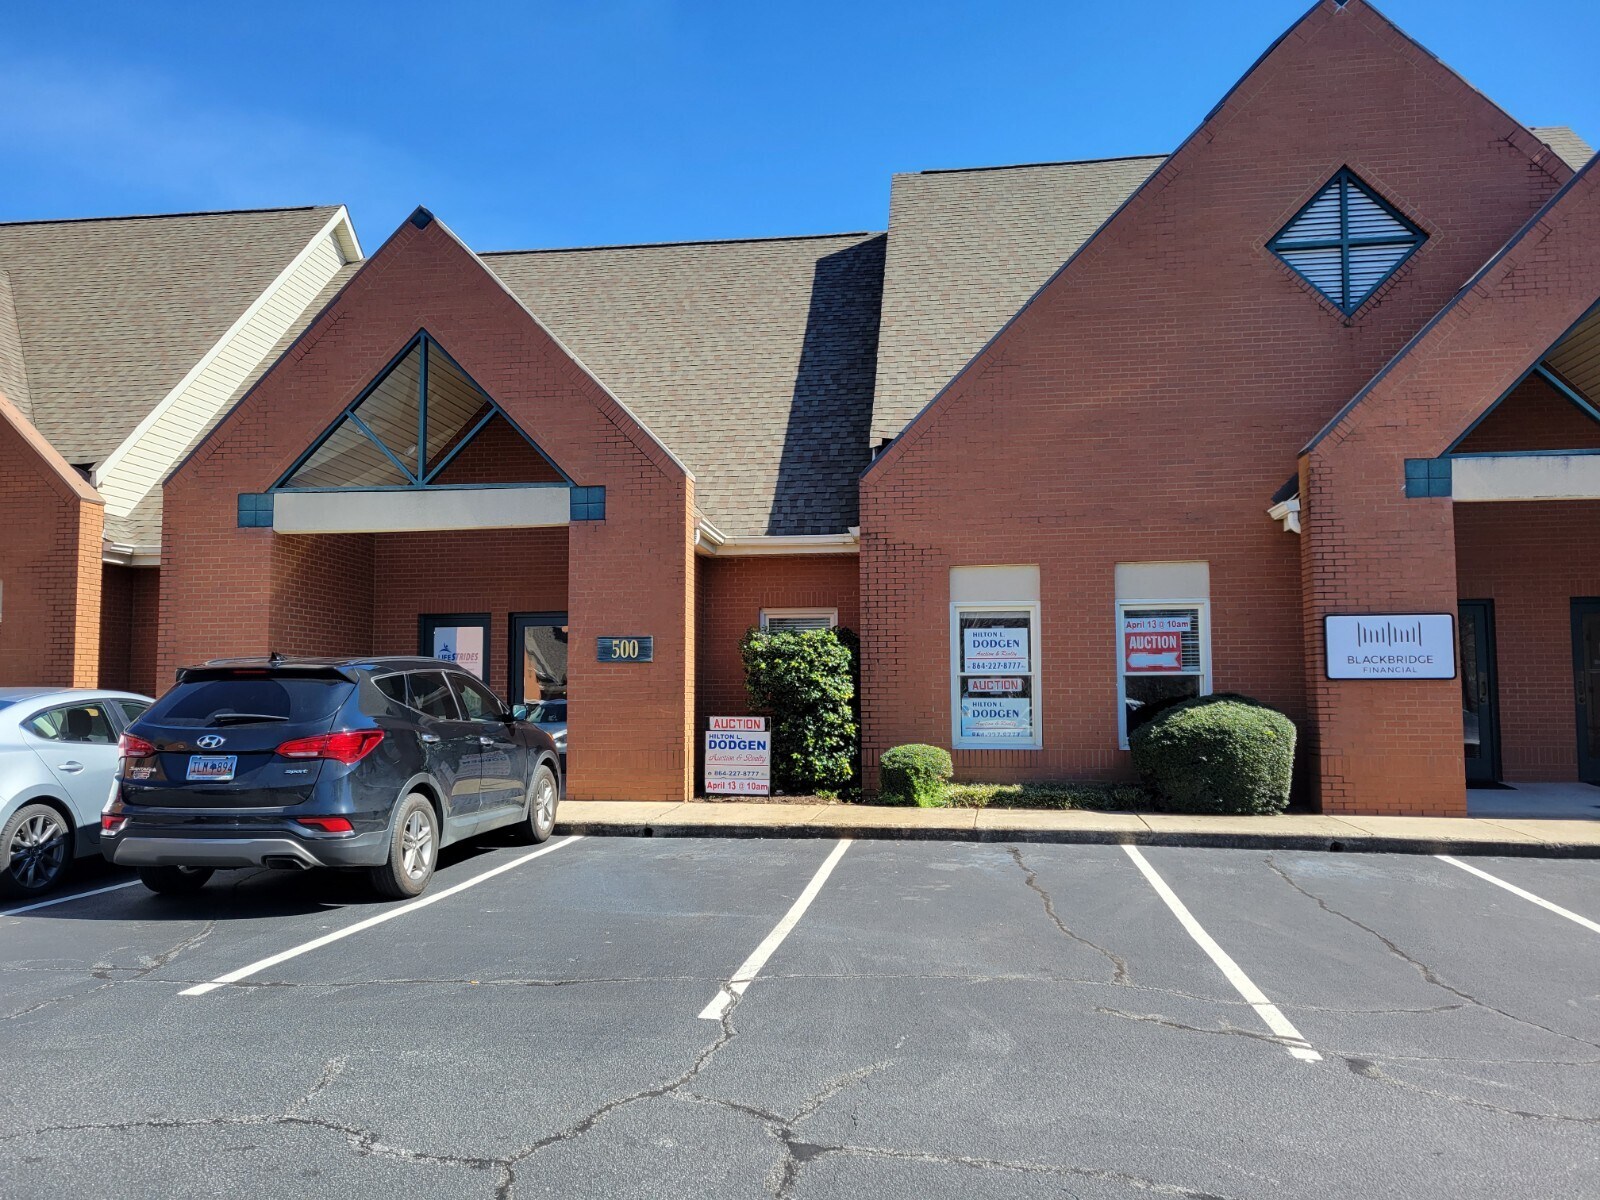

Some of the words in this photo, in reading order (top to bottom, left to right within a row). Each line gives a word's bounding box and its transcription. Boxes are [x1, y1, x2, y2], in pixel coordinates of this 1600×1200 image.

[1126, 620, 1145, 629] April
[1147, 619, 1157, 628] 13
[1167, 620, 1189, 628] 10am
[972, 639, 1020, 649] DODGEN
[1129, 635, 1177, 649] AUCTION
[611, 639, 639, 659] 500
[1347, 654, 1434, 664] BLACKBRIDGE
[1363, 666, 1418, 674] FINANCIAL
[972, 680, 1019, 690] AUCTION
[972, 709, 1020, 718] DODGEN
[713, 718, 761, 730] AUCTION
[708, 740, 767, 751] DODGEN
[708, 753, 735, 762] Auction
[706, 781, 725, 791] April
[728, 780, 737, 790] 13
[747, 781, 769, 791] 10am
